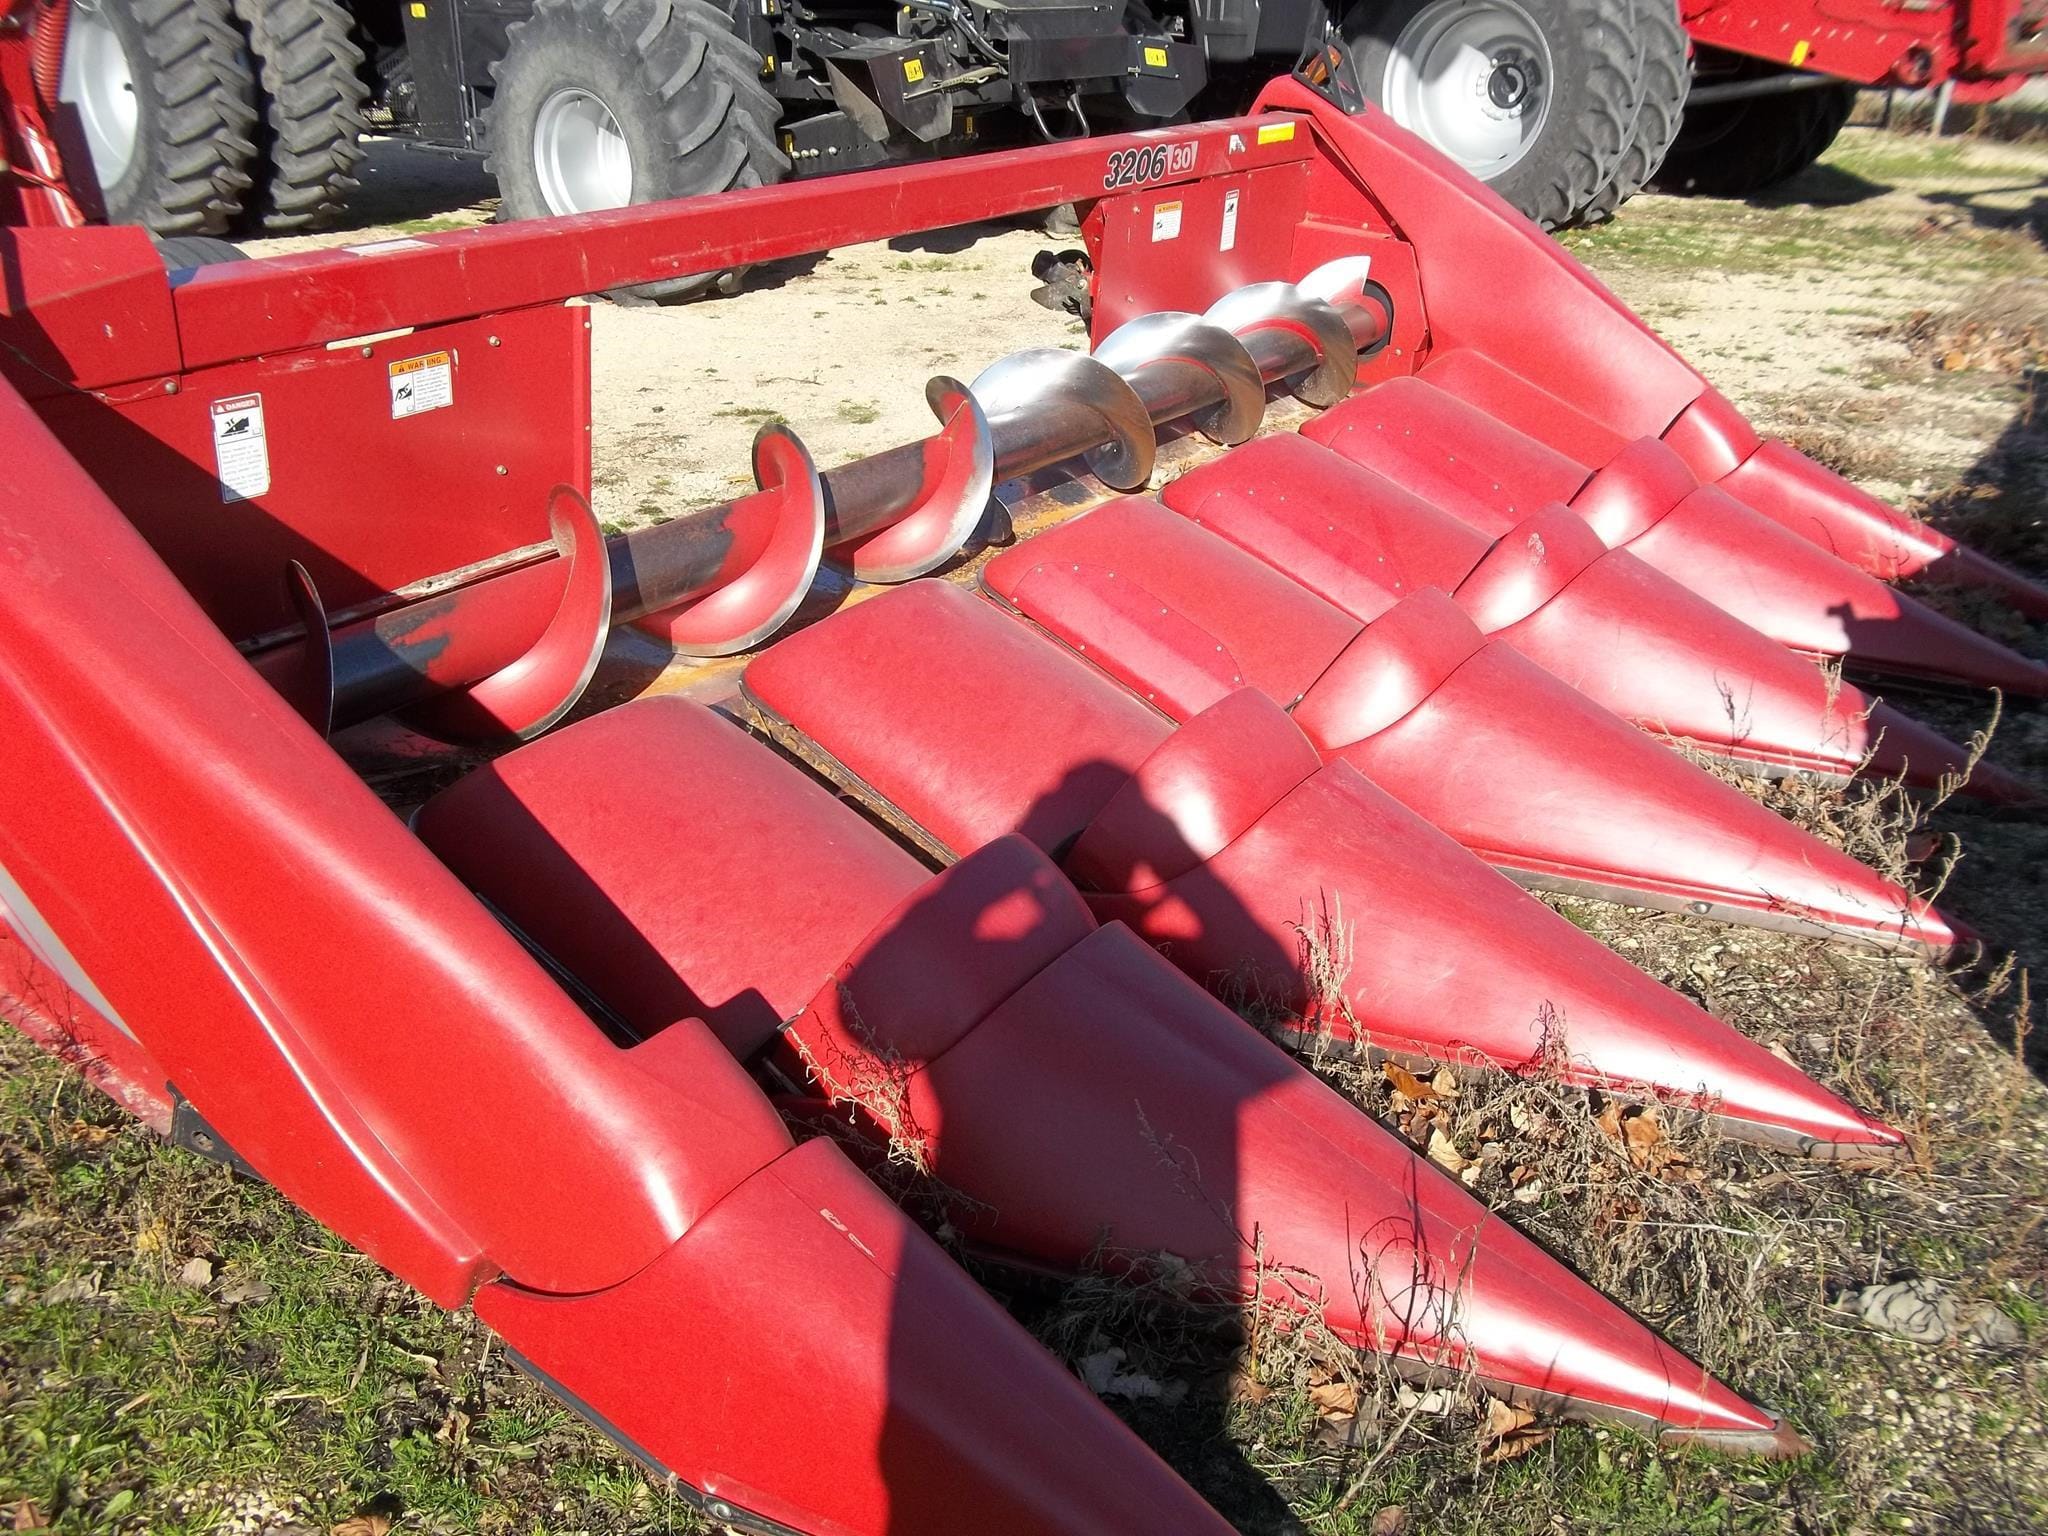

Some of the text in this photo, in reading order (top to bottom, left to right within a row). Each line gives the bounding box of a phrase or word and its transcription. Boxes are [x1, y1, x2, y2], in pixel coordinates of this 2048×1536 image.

[1104, 144, 1191, 190] 3206 30
[225, 399, 257, 411] DANGER
